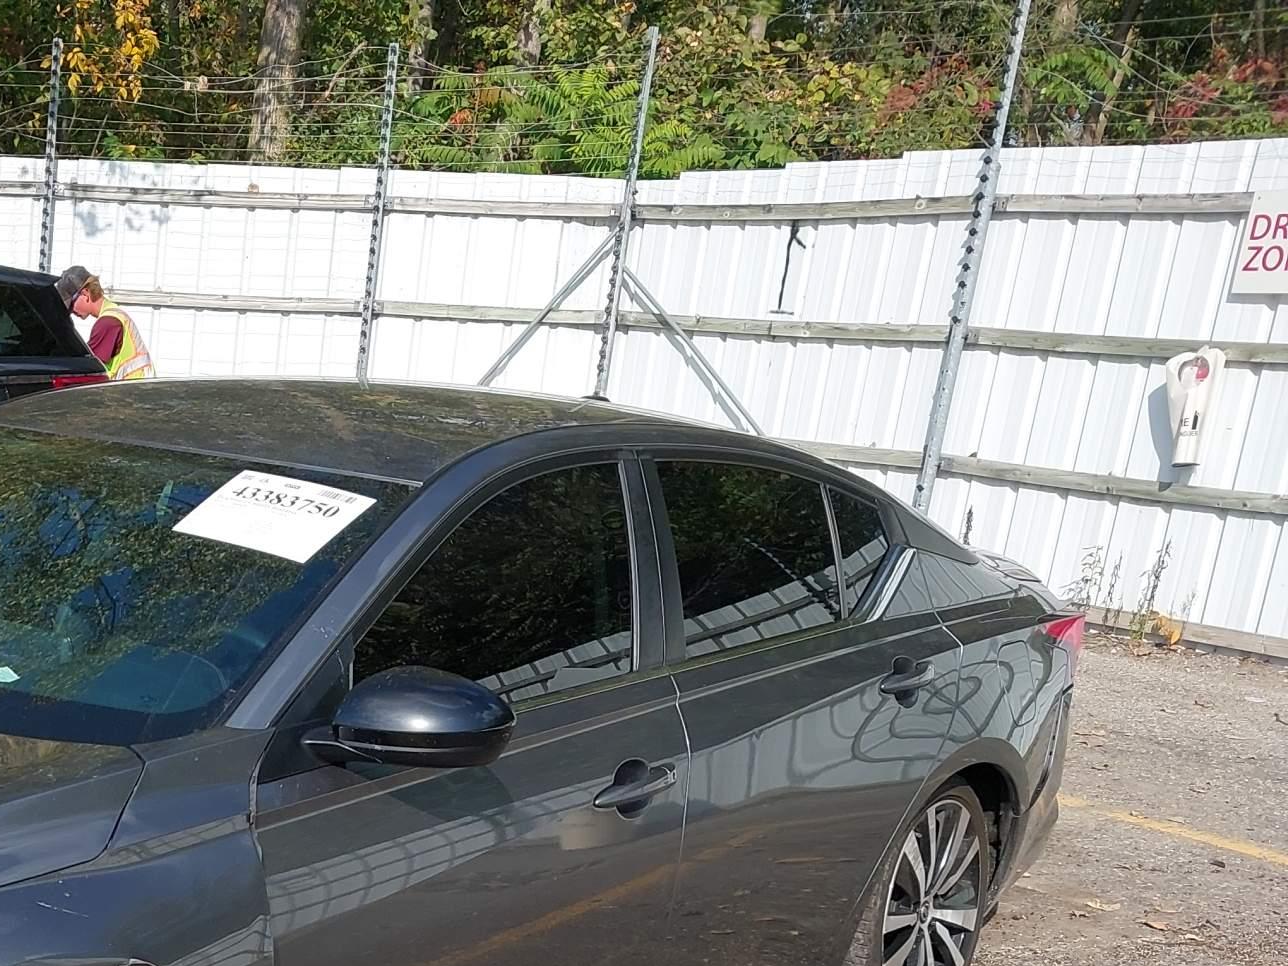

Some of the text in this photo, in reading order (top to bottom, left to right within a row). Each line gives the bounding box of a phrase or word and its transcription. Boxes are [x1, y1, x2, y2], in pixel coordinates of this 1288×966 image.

[1249, 213, 1288, 241] DR
[1242, 244, 1288, 272] ZO
[232, 486, 340, 518] 43383750
